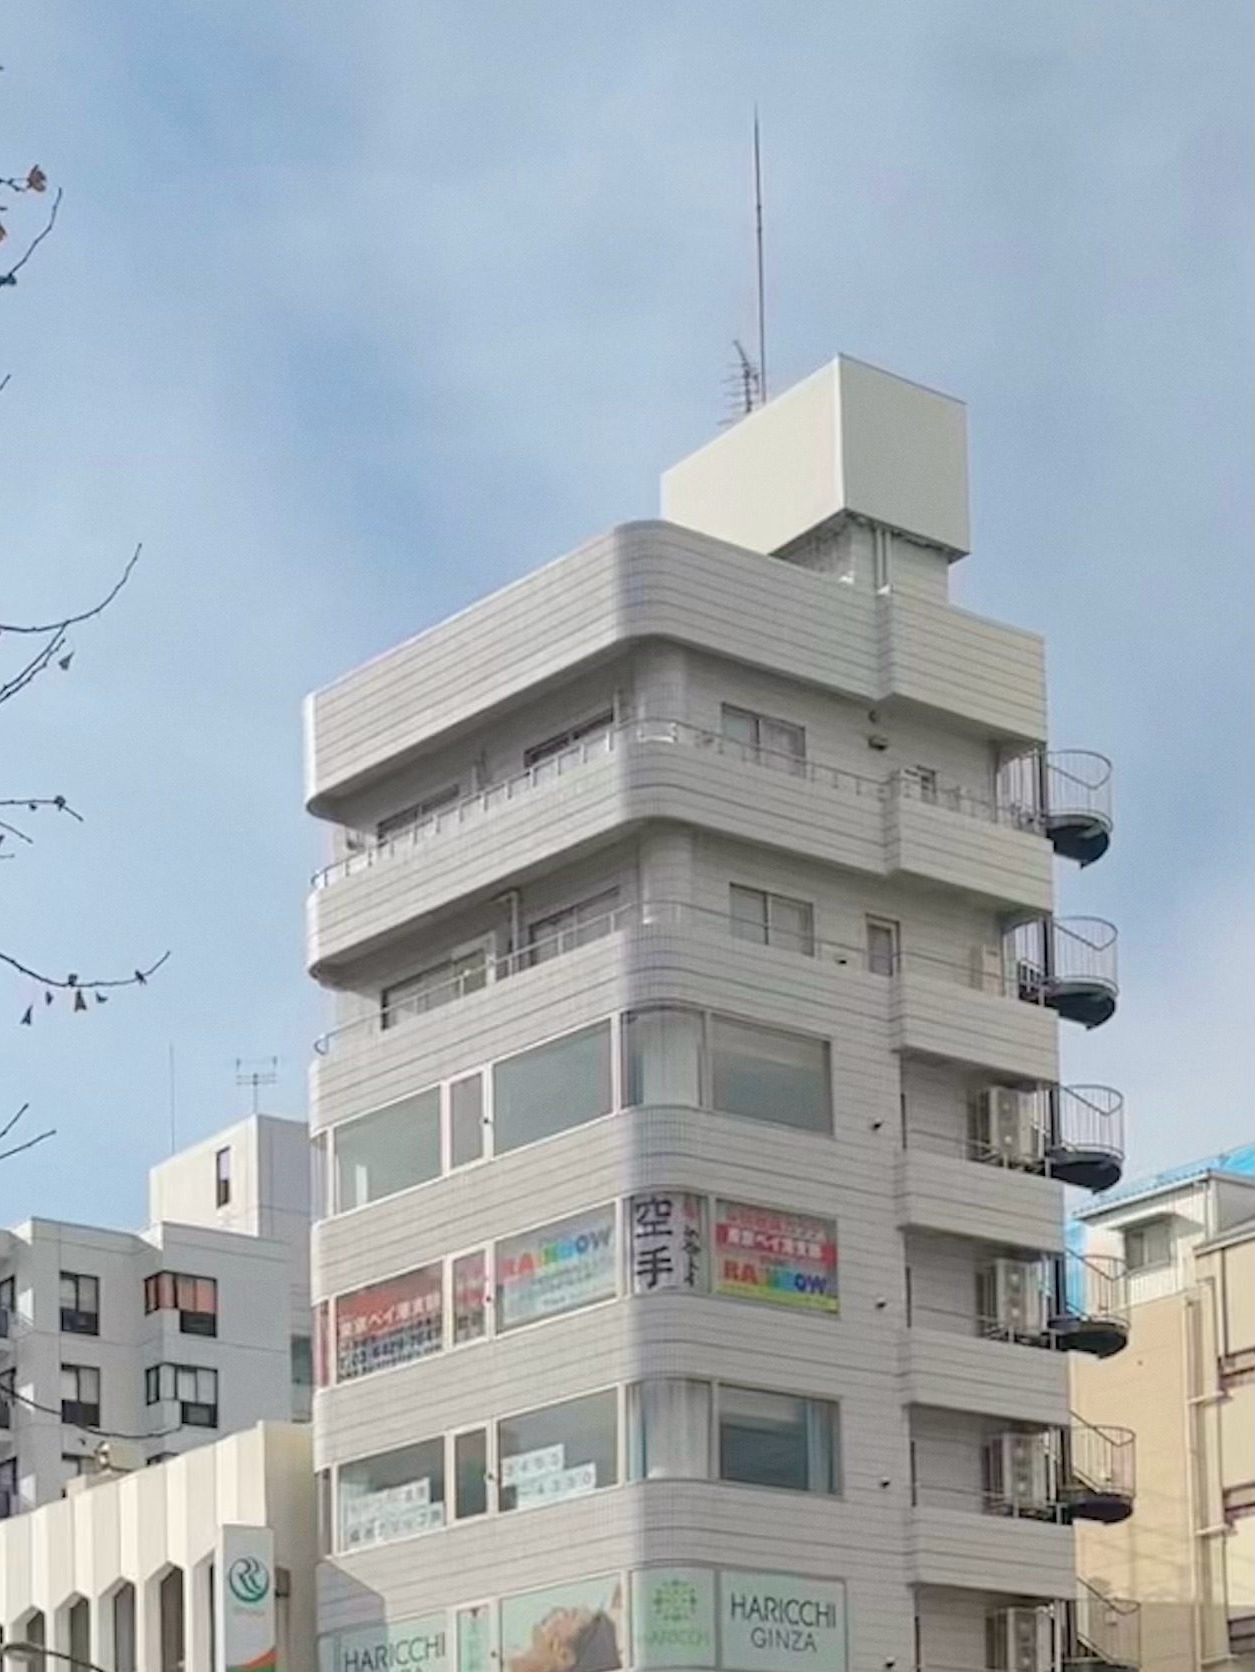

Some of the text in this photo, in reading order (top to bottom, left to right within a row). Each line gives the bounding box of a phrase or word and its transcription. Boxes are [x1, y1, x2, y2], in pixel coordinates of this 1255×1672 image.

[635, 1196, 674, 1290] 空手
[731, 1592, 837, 1629] HARICCHI
[750, 1626, 818, 1653] GINZA
